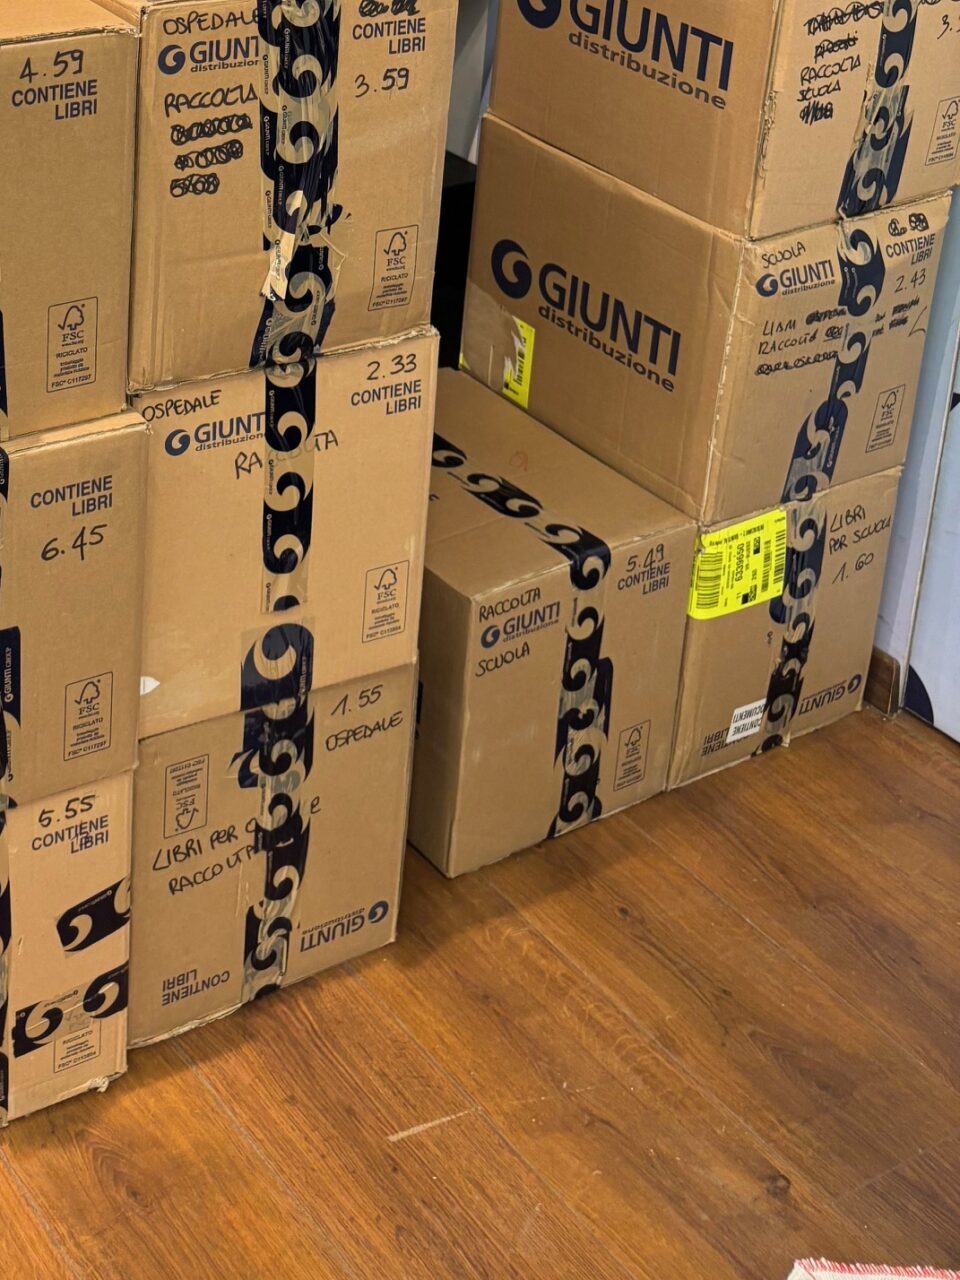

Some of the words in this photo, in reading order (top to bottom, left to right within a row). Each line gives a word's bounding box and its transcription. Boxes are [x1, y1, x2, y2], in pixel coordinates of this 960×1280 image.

[352, 18, 426, 40] CONTIENE
[190, 36, 259, 64] GIUNT
[388, 37, 426, 55] LIBRI
[19, 49, 84, 84] 4.59
[569, 30, 727, 110] distribuzione
[11, 79, 98, 108] CONTIENE
[355, 67, 409, 98] 3.59
[54, 100, 97, 121] LIBRI
[761, 241, 806, 269] SCUOLA
[886, 233, 936, 258] CONTIENE
[911, 248, 932, 266] LIBRI
[780, 260, 835, 288] GIUNTI
[782, 279, 835, 297] distribuzione
[539, 262, 681, 377] GIUNTI
[62, 330, 84, 342] FSC
[538, 305, 675, 393] distribuzione
[141, 389, 222, 422] OSPEDALE
[350, 379, 422, 407] CONTIENE
[386, 395, 422, 416] LIBRI
[194, 412, 265, 442] GIUNT
[195, 431, 264, 453] distribuzion
[30, 474, 113, 509] CONTIENE
[71, 493, 113, 517] LIBRI
[829, 505, 866, 533] LIBRI
[41, 524, 108, 561] 6.45
[617, 562, 670, 590] CONTIENE
[642, 577, 670, 595] LIBRI
[479, 587, 541, 622] RACCOLTA
[502, 601, 560, 637] GIUNTI
[475, 641, 530, 677] SCUOLA
[799, 684, 847, 716] GIUNTI
[32, 814, 109, 851] CONTIENE
[152, 839, 203, 871] LIBRI
[301, 914, 365, 951] GIUNTI
[162, 968, 197, 993] LIBRI
[162, 969, 230, 1007] CONTIENE
